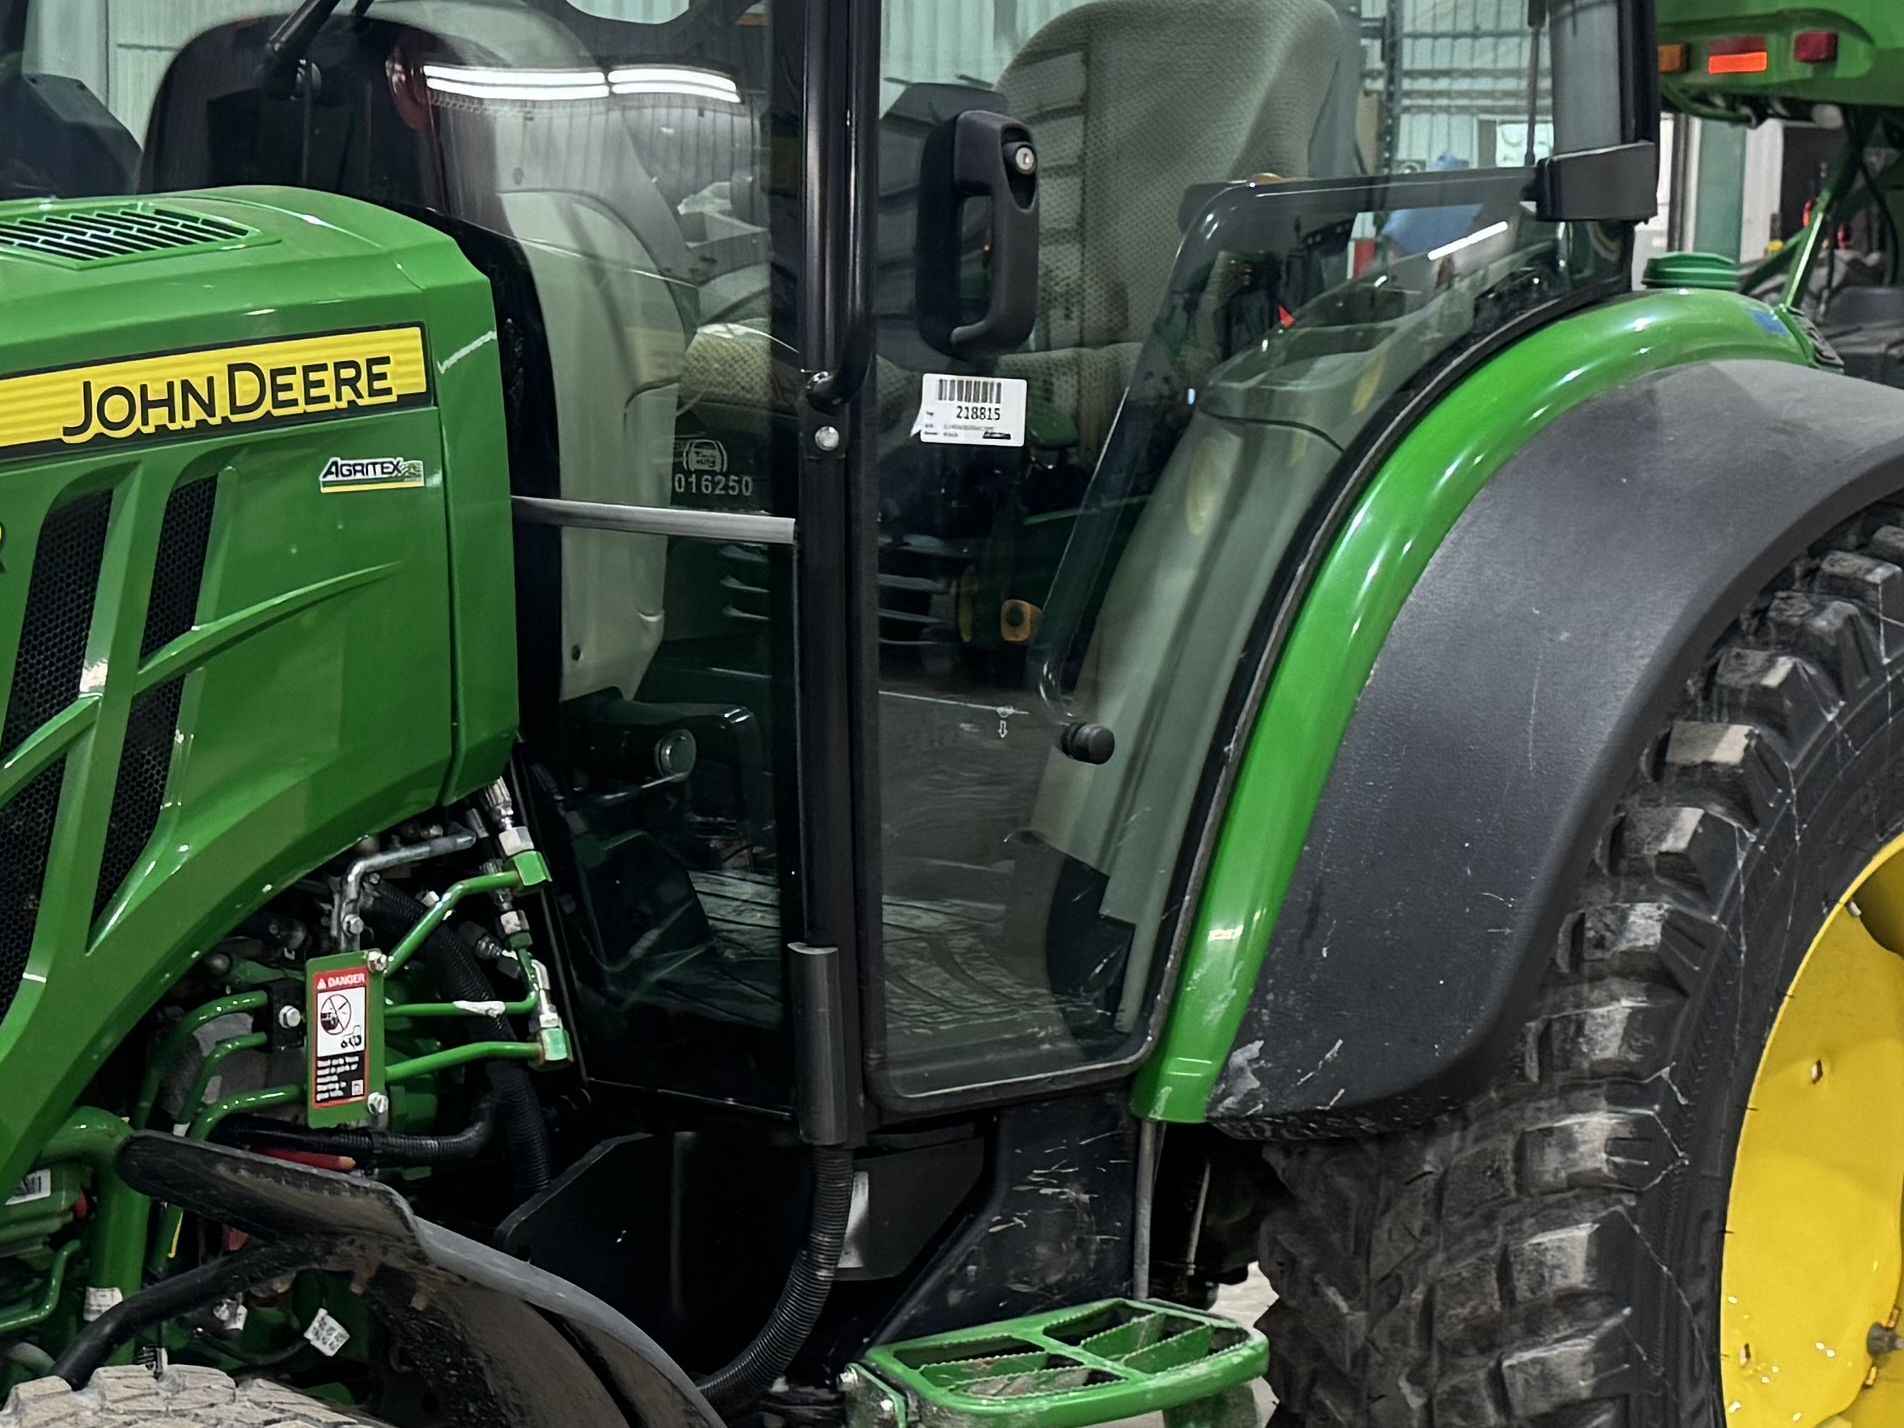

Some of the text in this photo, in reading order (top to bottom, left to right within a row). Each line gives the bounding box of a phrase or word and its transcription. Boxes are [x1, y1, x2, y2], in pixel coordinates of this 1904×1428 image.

[62, 356, 392, 438] JOHN DEERE
[956, 406, 1001, 421] 218815
[322, 460, 402, 479] AGRITEX
[675, 473, 753, 496] 016250
[327, 973, 366, 988] DANGER
